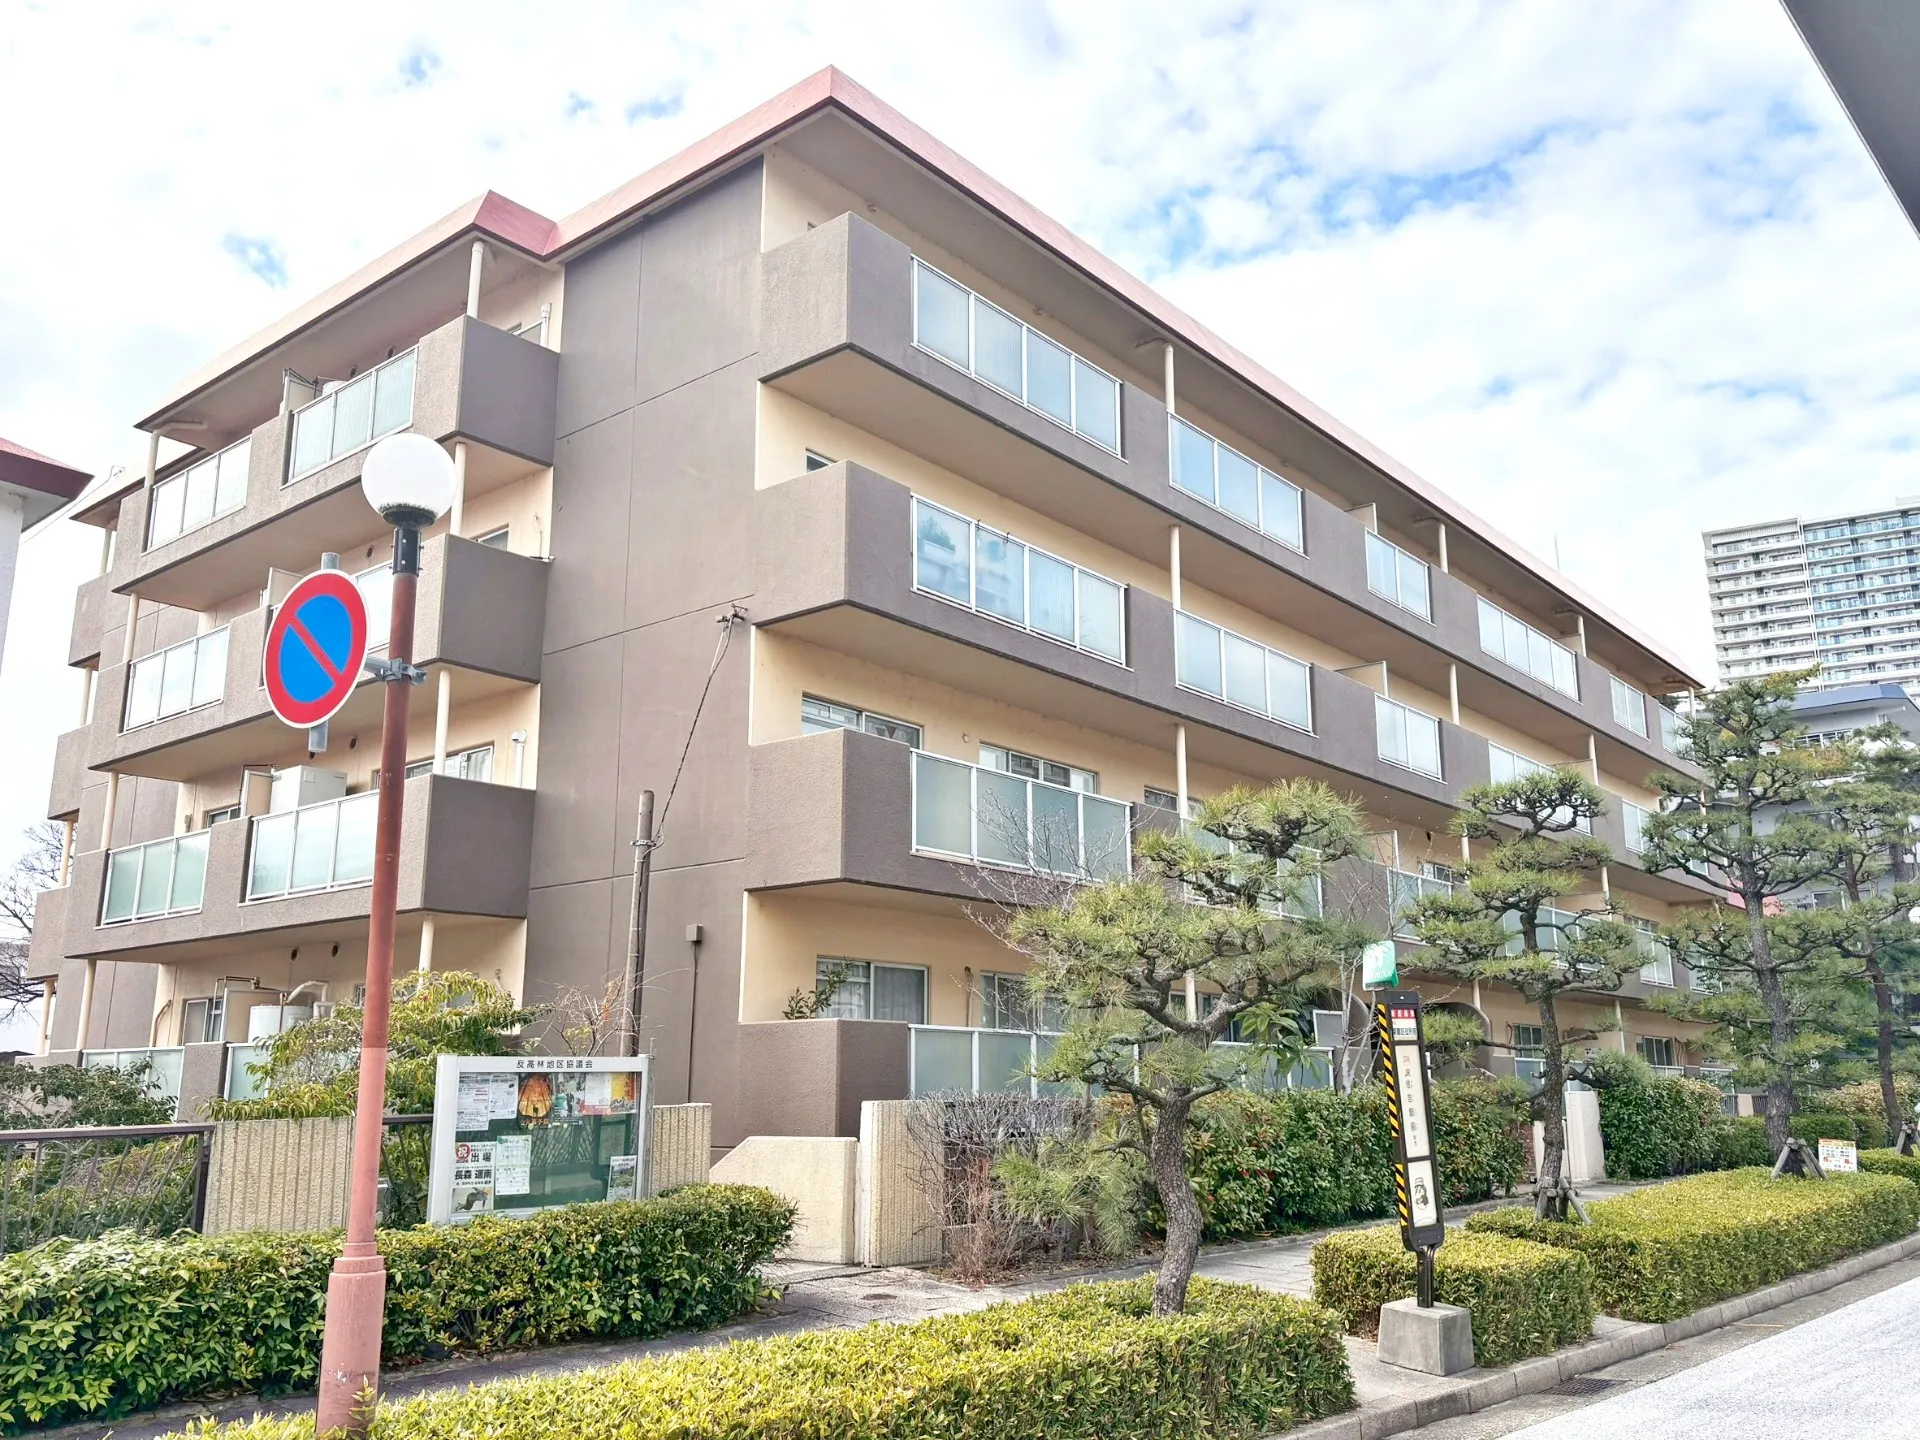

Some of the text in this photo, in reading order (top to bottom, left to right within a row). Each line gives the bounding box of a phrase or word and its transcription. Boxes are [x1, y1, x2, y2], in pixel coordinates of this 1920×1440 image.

[516, 1059, 593, 1069] 反高林地区協議会
